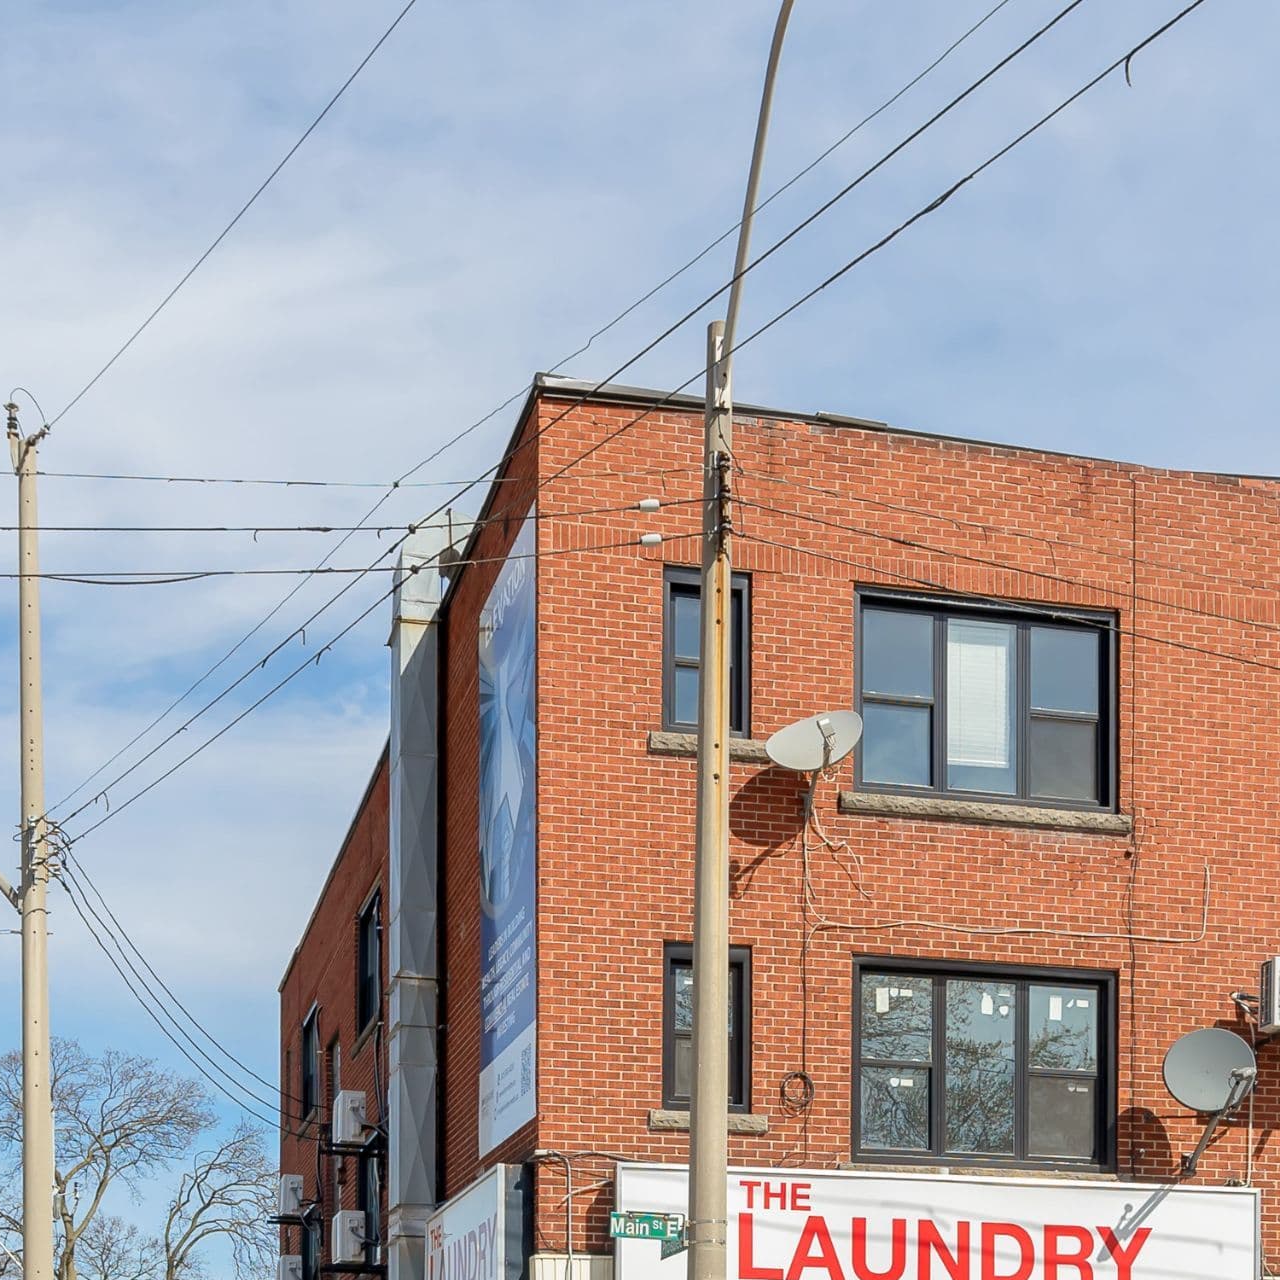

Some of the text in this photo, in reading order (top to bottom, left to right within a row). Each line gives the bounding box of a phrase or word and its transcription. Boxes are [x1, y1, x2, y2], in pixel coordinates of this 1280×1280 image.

[739, 1181, 811, 1211] THE
[431, 1225, 442, 1252] THE
[611, 1217, 678, 1237] Main St E
